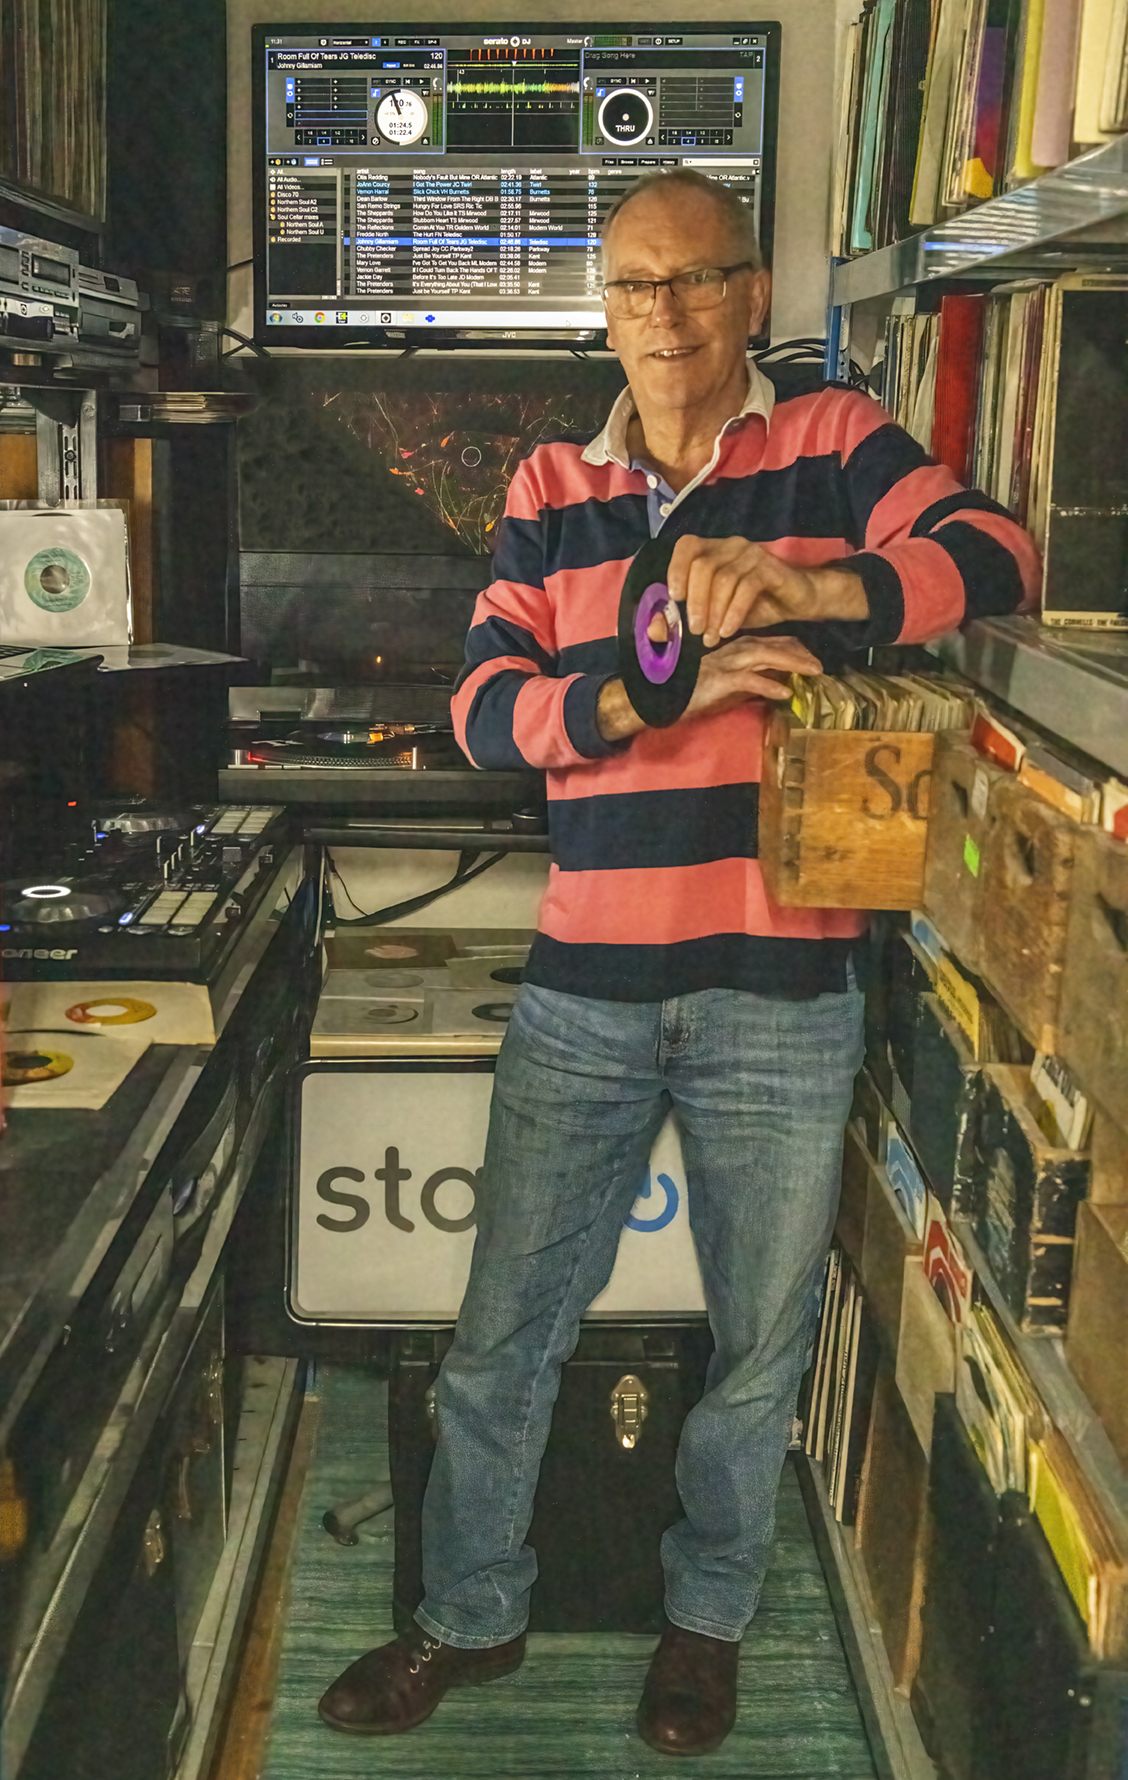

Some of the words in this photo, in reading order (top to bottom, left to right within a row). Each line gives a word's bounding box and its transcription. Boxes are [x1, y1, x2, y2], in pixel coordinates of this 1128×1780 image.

[277, 52, 297, 60] Room
[298, 52, 310, 60] Full
[310, 52, 320, 60] Of
[320, 52, 338, 60] Tears
[338, 52, 349, 60] JG
[349, 52, 377, 60] Teledisc
[430, 52, 443, 60] 120
[584, 52, 600, 60] Drag
[601, 52, 619, 60] Song
[277, 62, 296, 70] Johnny
[615, 125, 636, 133] THRU
[500, 168, 516, 176] length
[383, 202, 401, 210] Strings
[412, 202, 430, 210] Hungry
[1, 948, 78, 960] oneer
